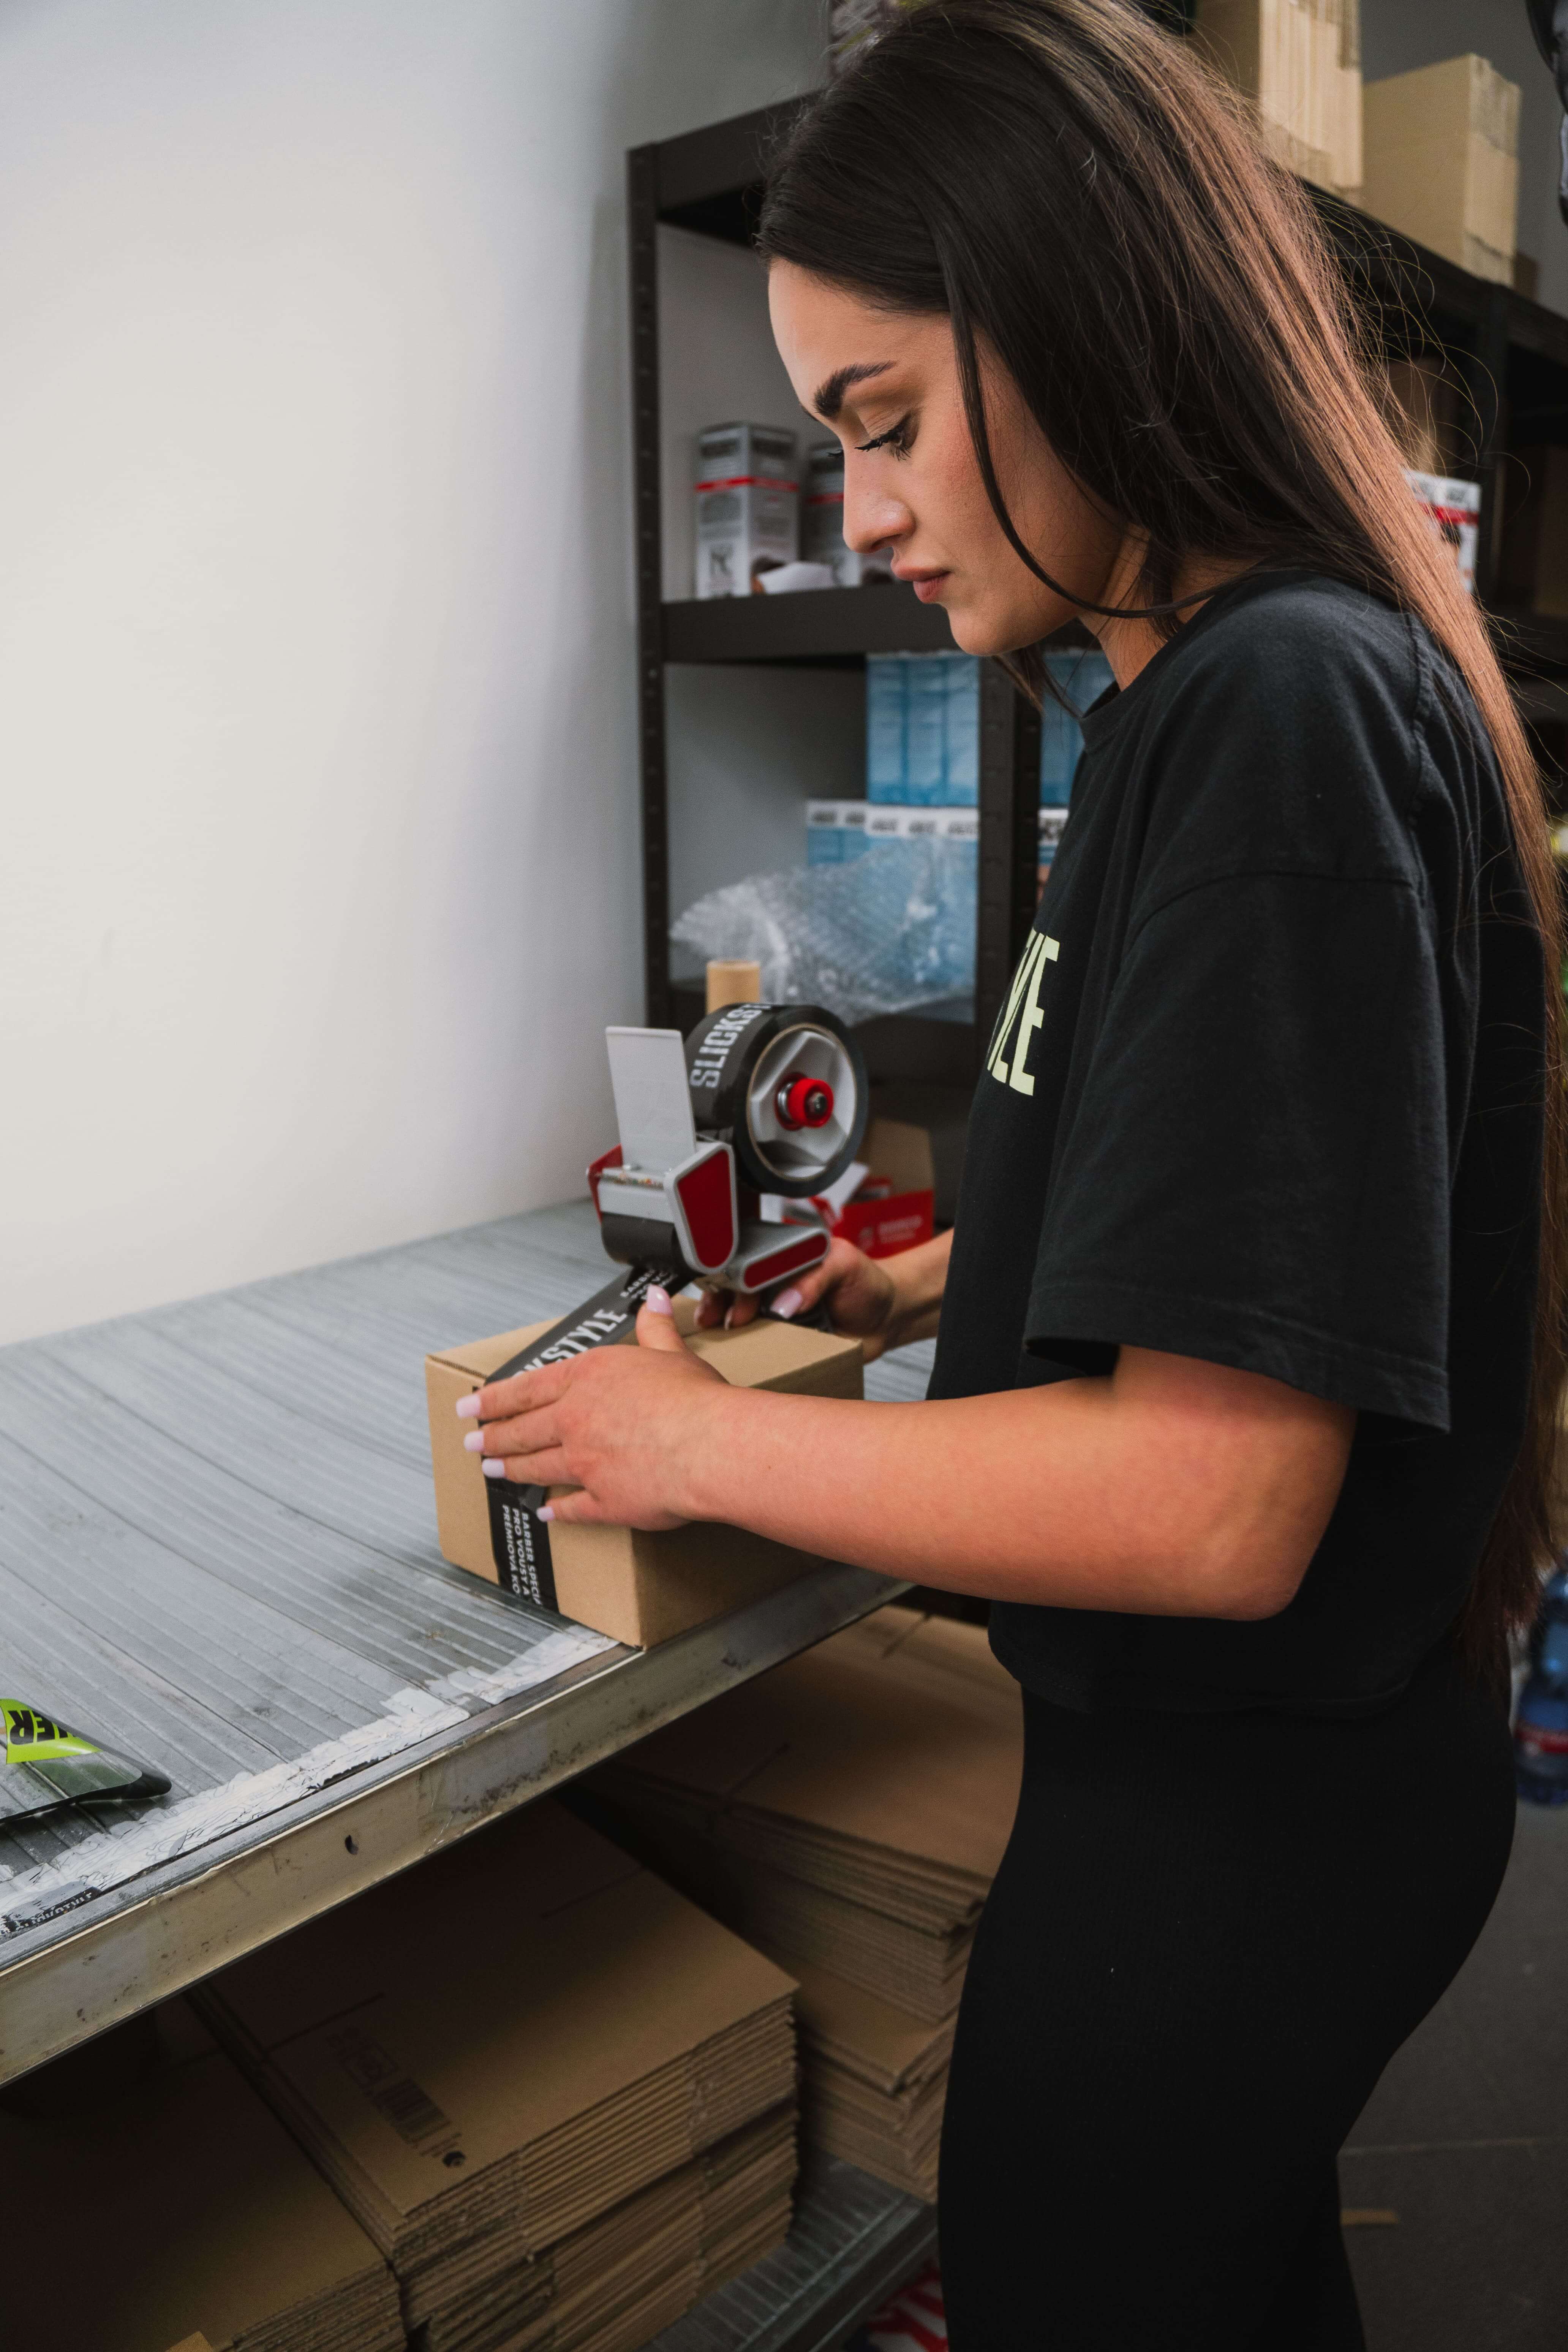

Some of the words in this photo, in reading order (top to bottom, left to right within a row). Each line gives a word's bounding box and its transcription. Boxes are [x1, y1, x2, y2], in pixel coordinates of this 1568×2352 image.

[987, 926, 1060, 1097] YLE
[514, 1309, 628, 1376] STYLE
[513, 1508, 522, 1536] PRO
[522, 1512, 534, 1562] BARBER
[516, 1539, 528, 1585] VOUSY
[522, 1585, 530, 1595] A
